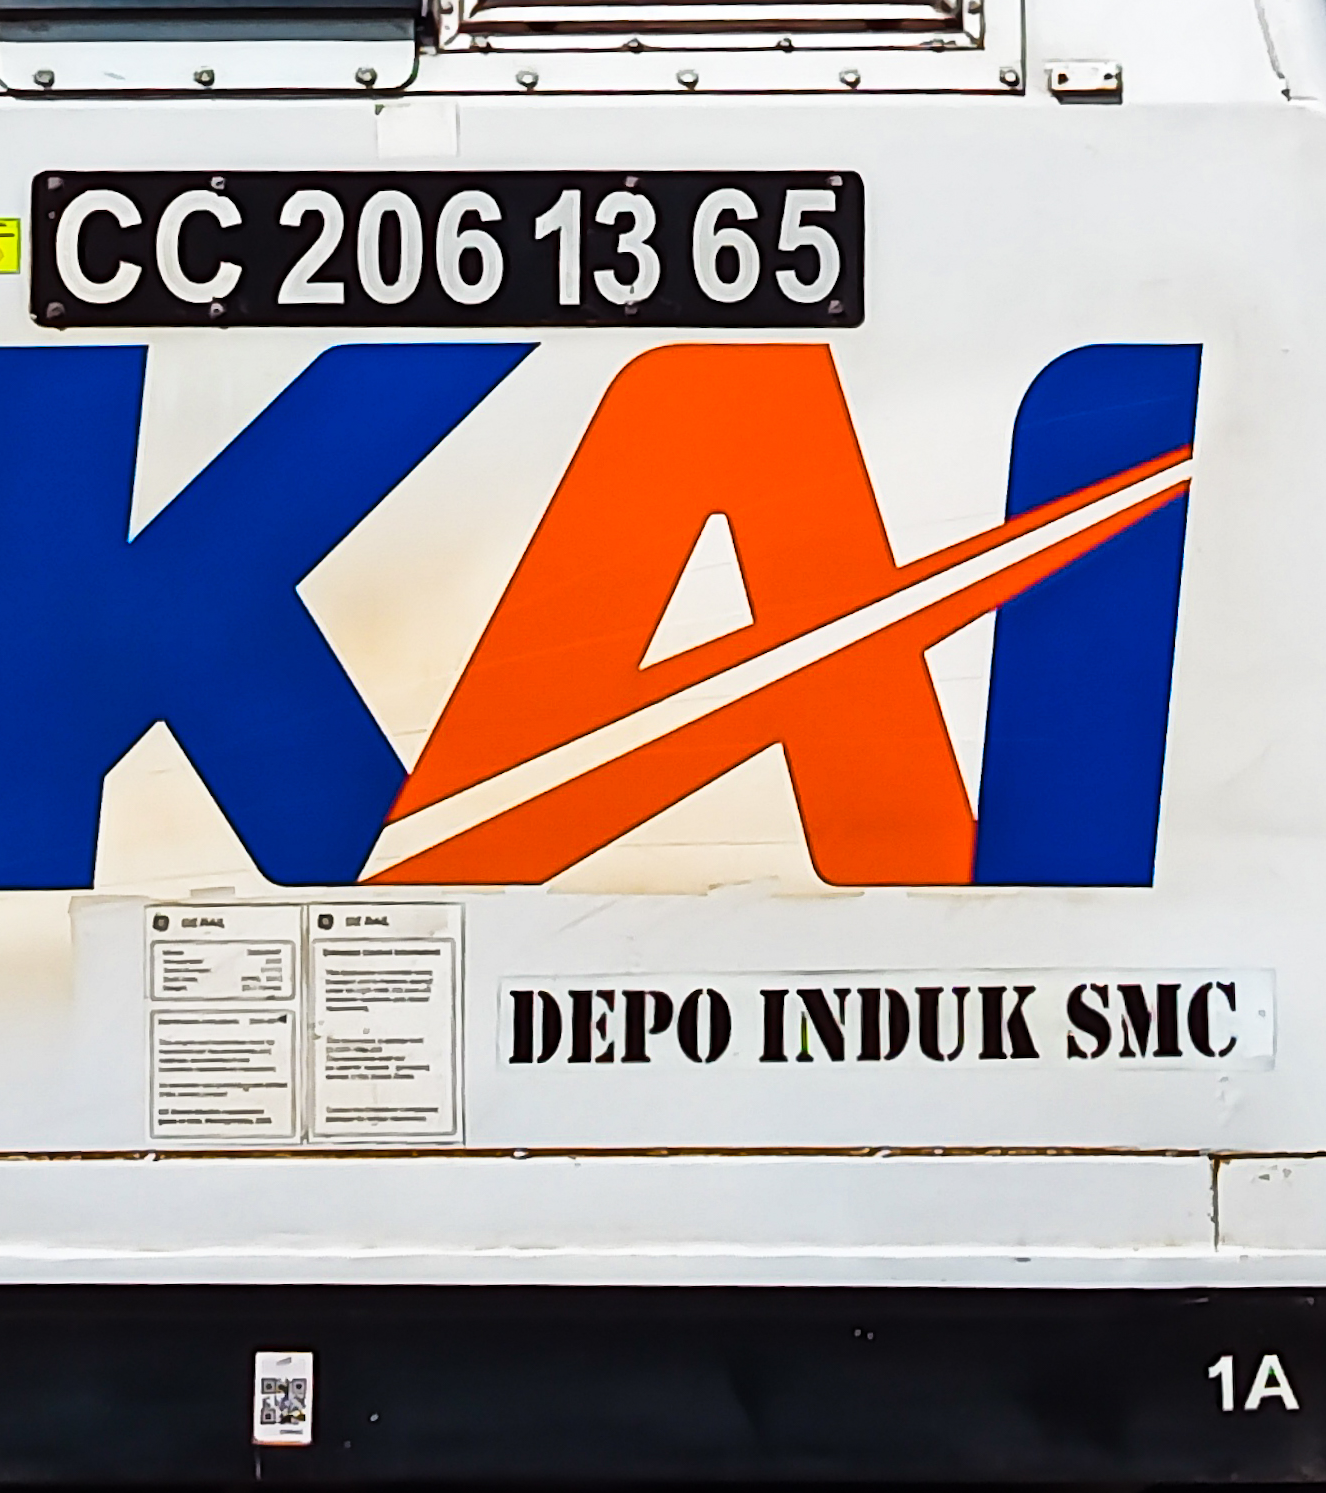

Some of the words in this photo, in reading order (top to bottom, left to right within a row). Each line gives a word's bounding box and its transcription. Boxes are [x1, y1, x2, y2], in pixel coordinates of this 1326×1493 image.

[58, 189, 243, 304] CC
[277, 189, 504, 305] 206
[534, 189, 661, 306] 13
[692, 188, 841, 304] 65
[508, 988, 733, 1064] DEPO
[758, 985, 1040, 1063] INDUK
[1066, 981, 1238, 1060] SMC
[1207, 1354, 1301, 1412] 1A
